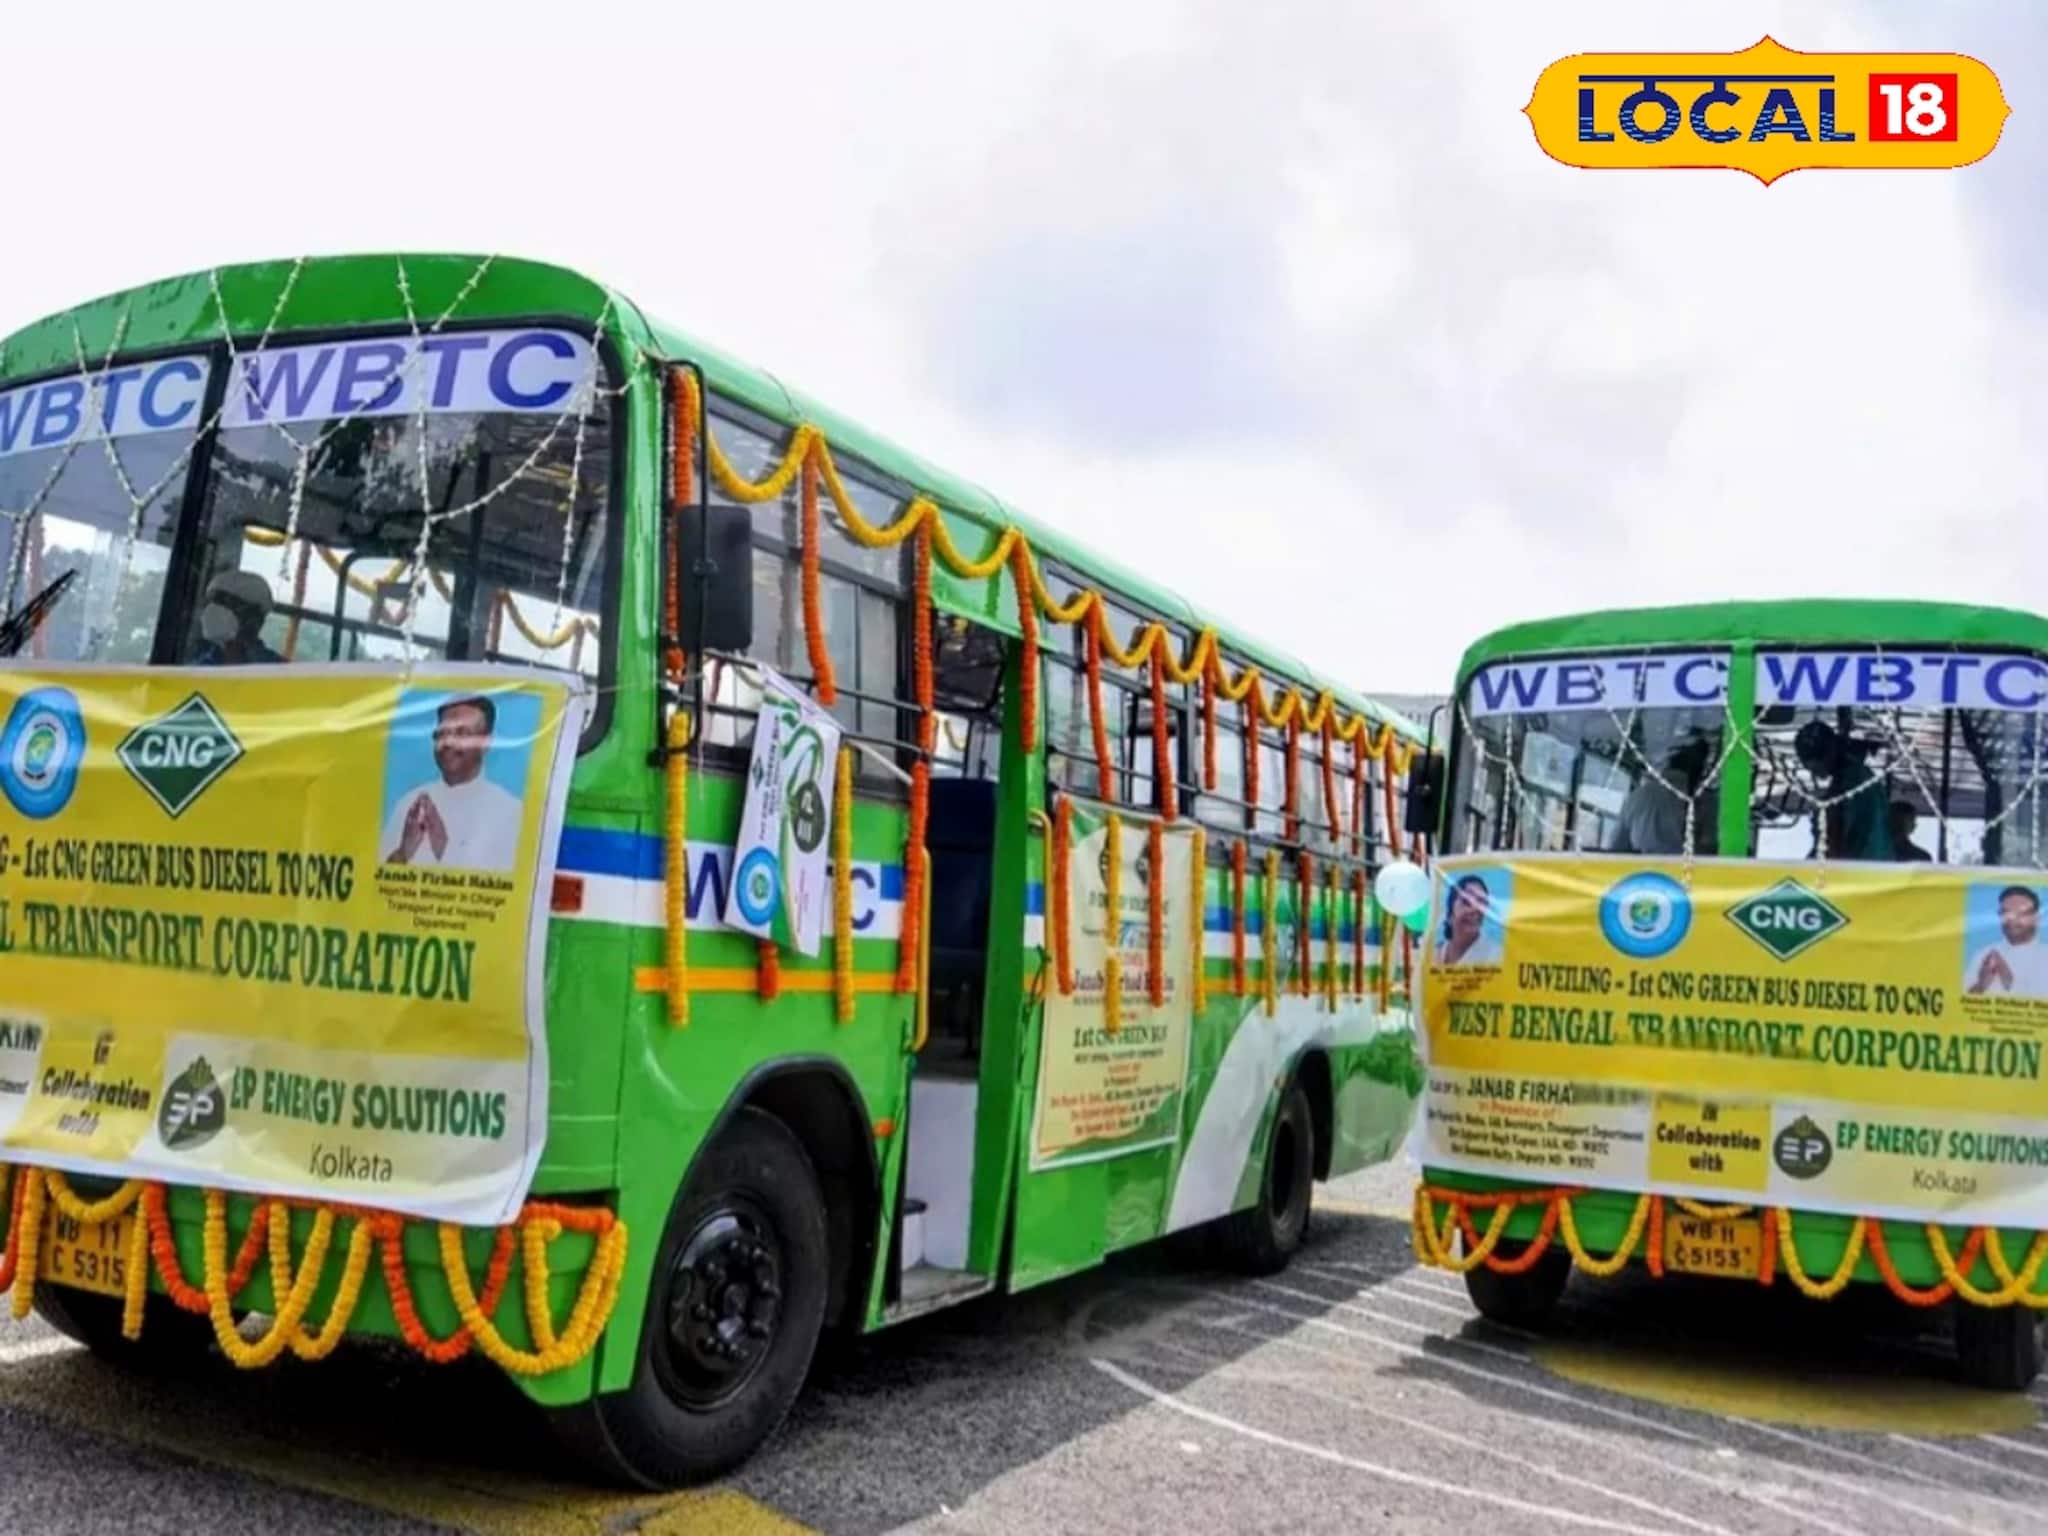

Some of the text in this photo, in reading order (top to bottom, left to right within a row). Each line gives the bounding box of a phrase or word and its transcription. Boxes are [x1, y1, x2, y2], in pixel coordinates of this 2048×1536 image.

[242, 332, 578, 421] WBTC
[1478, 657, 1729, 710] WBTC
[1764, 654, 2048, 709] WBTC
[140, 734, 217, 768] CNG
[24, 837, 49, 878] 1st
[53, 837, 87, 882] CNG
[91, 841, 151, 885] GREEN
[155, 844, 194, 889] BUS
[201, 847, 272, 894] DIESEL
[277, 853, 301, 897] TO
[304, 853, 354, 902] CNG
[1749, 904, 1822, 931] CNG
[24, 901, 204, 968] TRANSPORT
[213, 916, 476, 1002] CORPORATION
[1518, 963, 1612, 995] UNVEILING
[1628, 970, 1653, 997] 1st
[1657, 971, 1694, 999] CNG
[1698, 973, 1759, 1003] GREEN
[1763, 977, 1800, 1007] BUS
[1804, 981, 1868, 1013] DIESEL
[1875, 985, 1900, 1013] TO
[1903, 986, 1943, 1017] CNG
[1447, 1001, 2042, 1081] WEST BENGAL TRANSPORT CORPORATION
[230, 1066, 506, 1140] EP ENERGY SOLUTIONS
[1466, 1076, 1515, 1101] JANAB
[1520, 1081, 1574, 1105] FIRHA
[1656, 1122, 1762, 1150] Collaboration
[1837, 1120, 2048, 1166] EP ENERGY SOLUTIONS
[310, 1143, 392, 1183] Kolkata
[1690, 1153, 1723, 1172] with
[1911, 1168, 1977, 1195] Kolkata
[1680, 1221, 1713, 1240] WB
[74, 1248, 125, 1287] 5315
